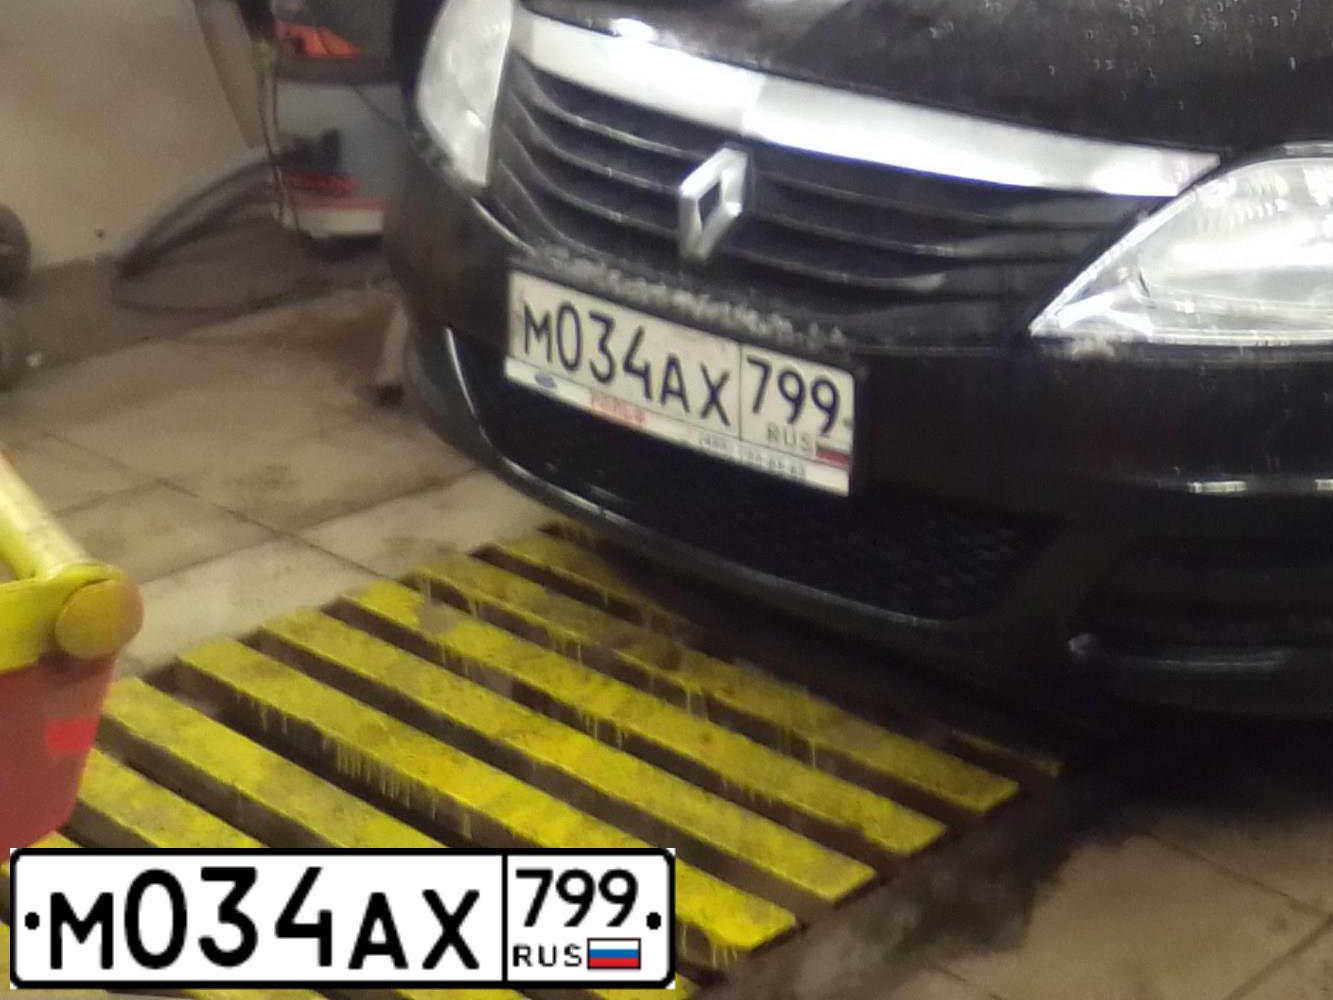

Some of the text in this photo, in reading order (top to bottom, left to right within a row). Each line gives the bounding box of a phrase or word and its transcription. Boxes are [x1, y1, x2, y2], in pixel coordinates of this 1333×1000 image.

[523, 302, 840, 434] М034АХ 799
[767, 423, 813, 452] RUS
